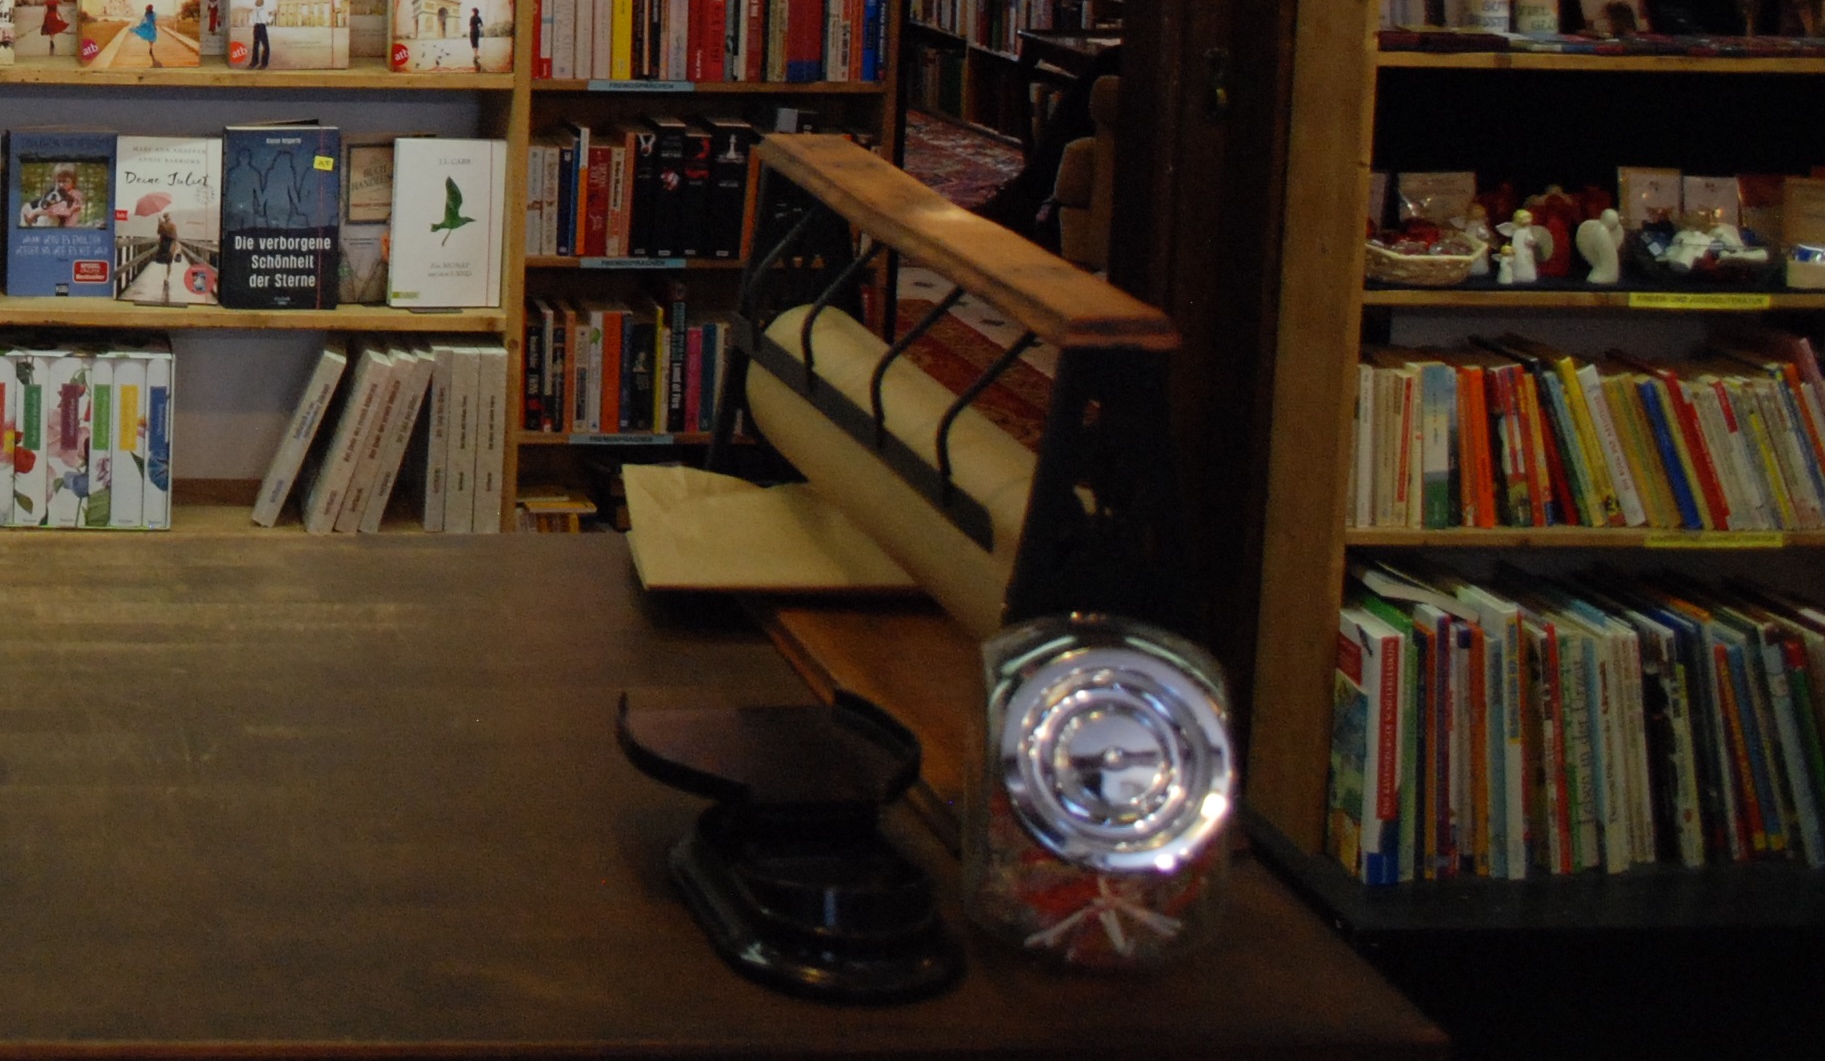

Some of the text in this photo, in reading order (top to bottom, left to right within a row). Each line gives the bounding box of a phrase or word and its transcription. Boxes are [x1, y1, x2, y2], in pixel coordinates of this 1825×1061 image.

[82, 43, 99, 57] atb
[230, 46, 248, 59] atb
[124, 171, 209, 187] Deine Juliet
[234, 235, 331, 252] Die verborgene
[251, 254, 315, 269] Schönheit
[249, 273, 316, 288] der Sterne
